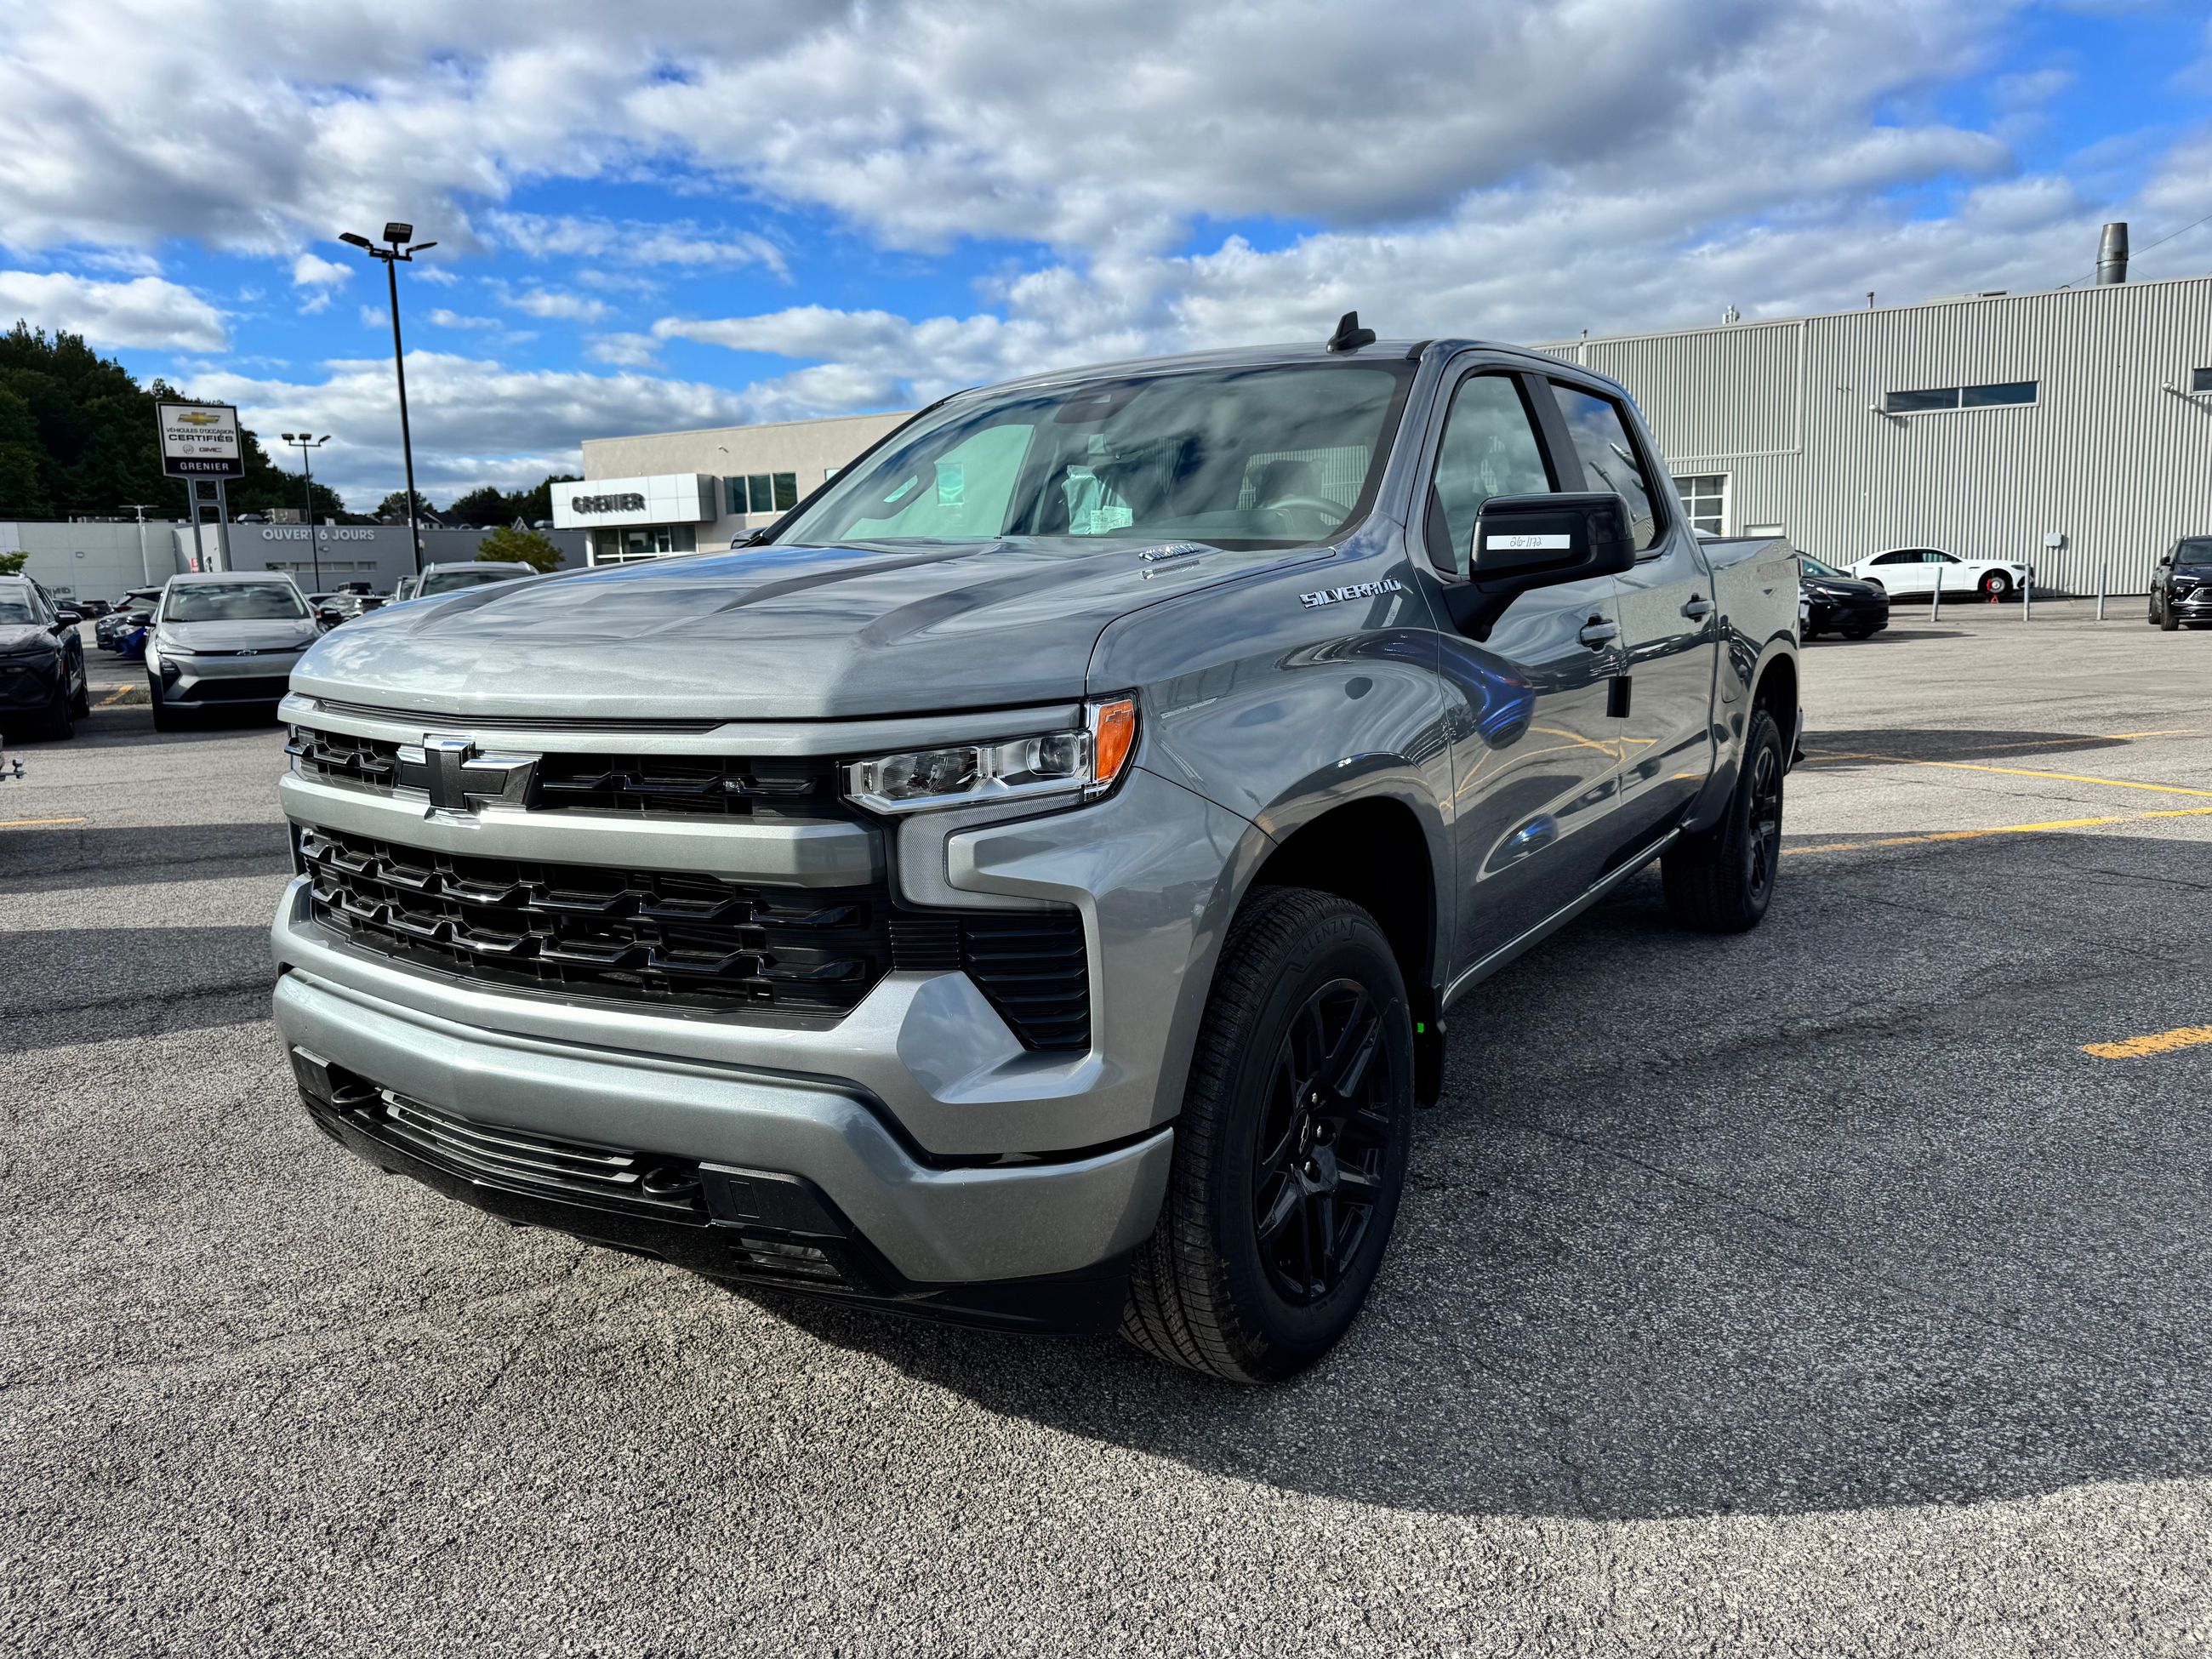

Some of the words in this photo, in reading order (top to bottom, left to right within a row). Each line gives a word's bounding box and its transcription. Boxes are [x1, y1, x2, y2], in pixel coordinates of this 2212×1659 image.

[168, 433, 234, 442] CERTIFIÉS
[180, 462, 230, 470] GRENIER
[572, 493, 647, 515] GRENIER
[319, 528, 328, 540] 6
[332, 529, 375, 540] JOURS
[1299, 578, 1402, 609] SILVERADO
[1300, 918, 1348, 959] ALENZA
